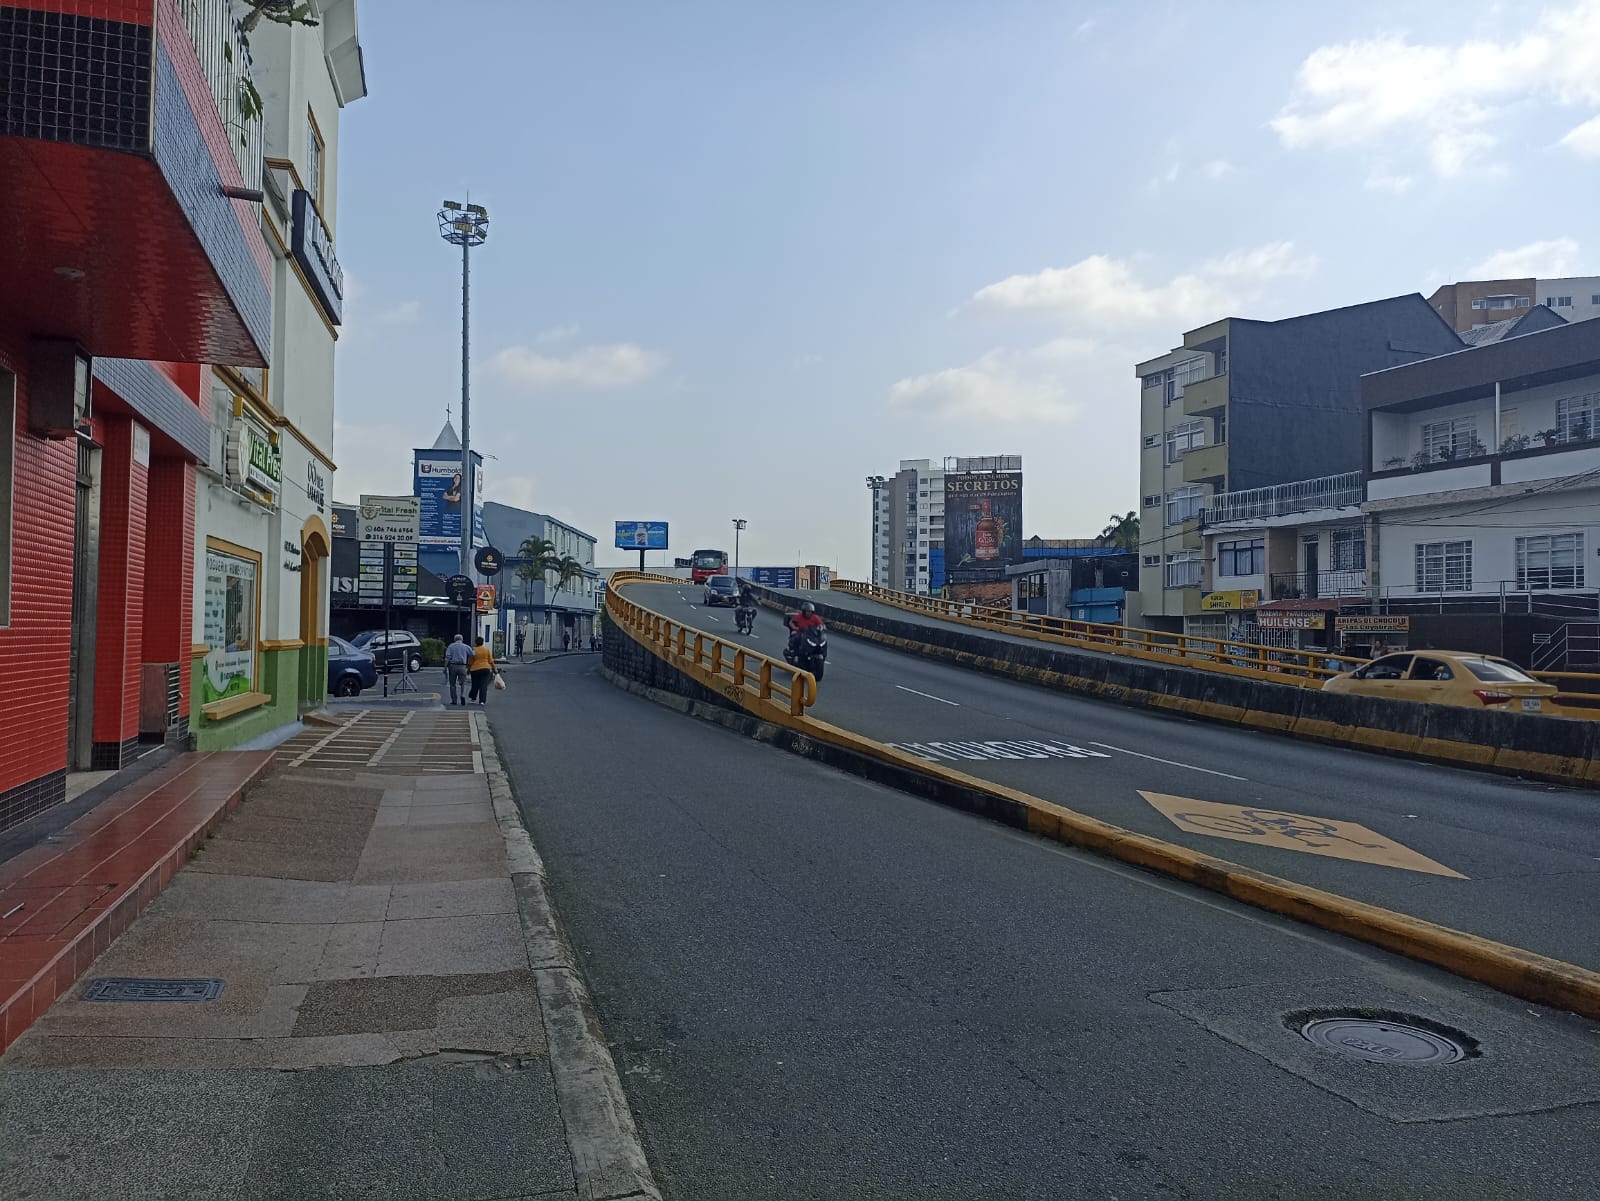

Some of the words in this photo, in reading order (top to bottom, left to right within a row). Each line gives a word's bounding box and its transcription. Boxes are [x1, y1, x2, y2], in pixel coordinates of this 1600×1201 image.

[247, 431, 267, 472] Vital
[432, 465, 462, 474] Humbold
[947, 480, 1018, 492] SECRETOS
[395, 506, 417, 515] Fresh
[1210, 601, 1232, 609] SHIRLEY
[1260, 617, 1310, 628] HUILENSE
